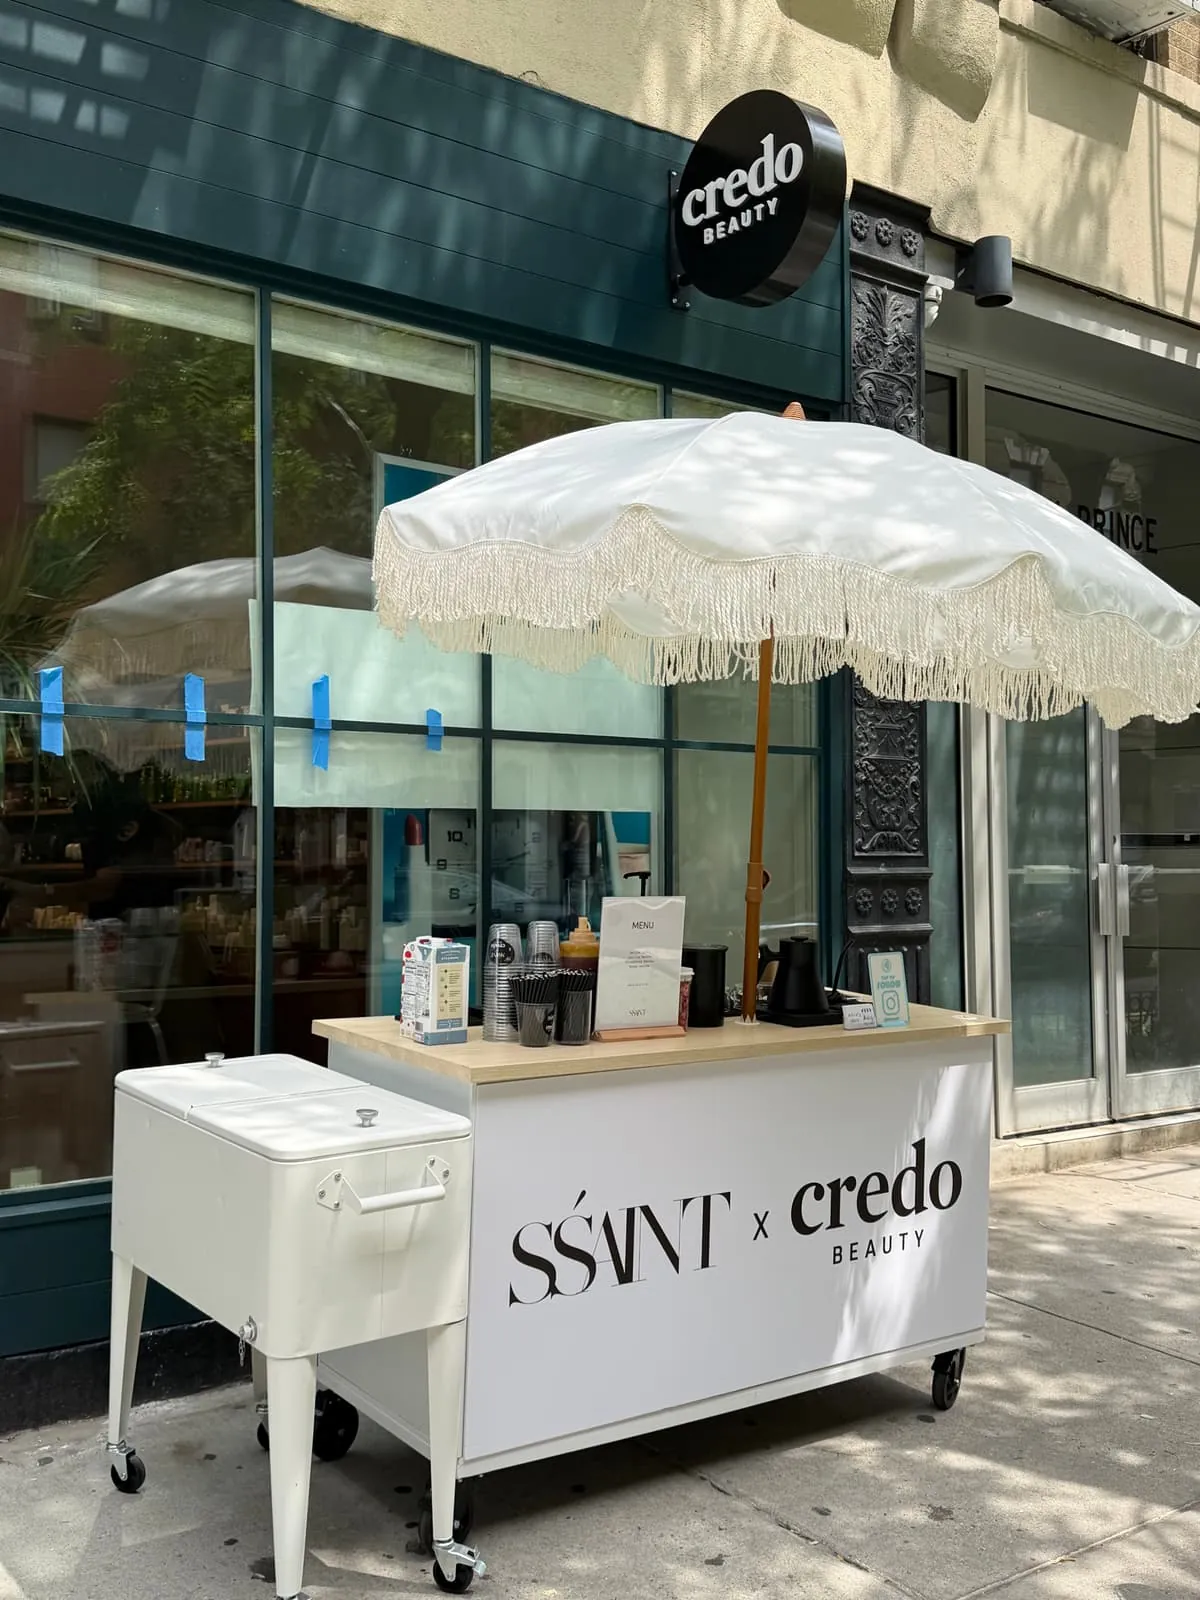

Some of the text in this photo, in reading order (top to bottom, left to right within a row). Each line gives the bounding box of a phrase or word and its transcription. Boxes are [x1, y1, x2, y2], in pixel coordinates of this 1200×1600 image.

[682, 133, 804, 226] credo
[703, 197, 778, 245] BEAUTY
[447, 830, 463, 842] 10
[631, 921, 655, 930] MENU
[790, 1136, 963, 1237] credo
[832, 1229, 925, 1265] BEAUTY
